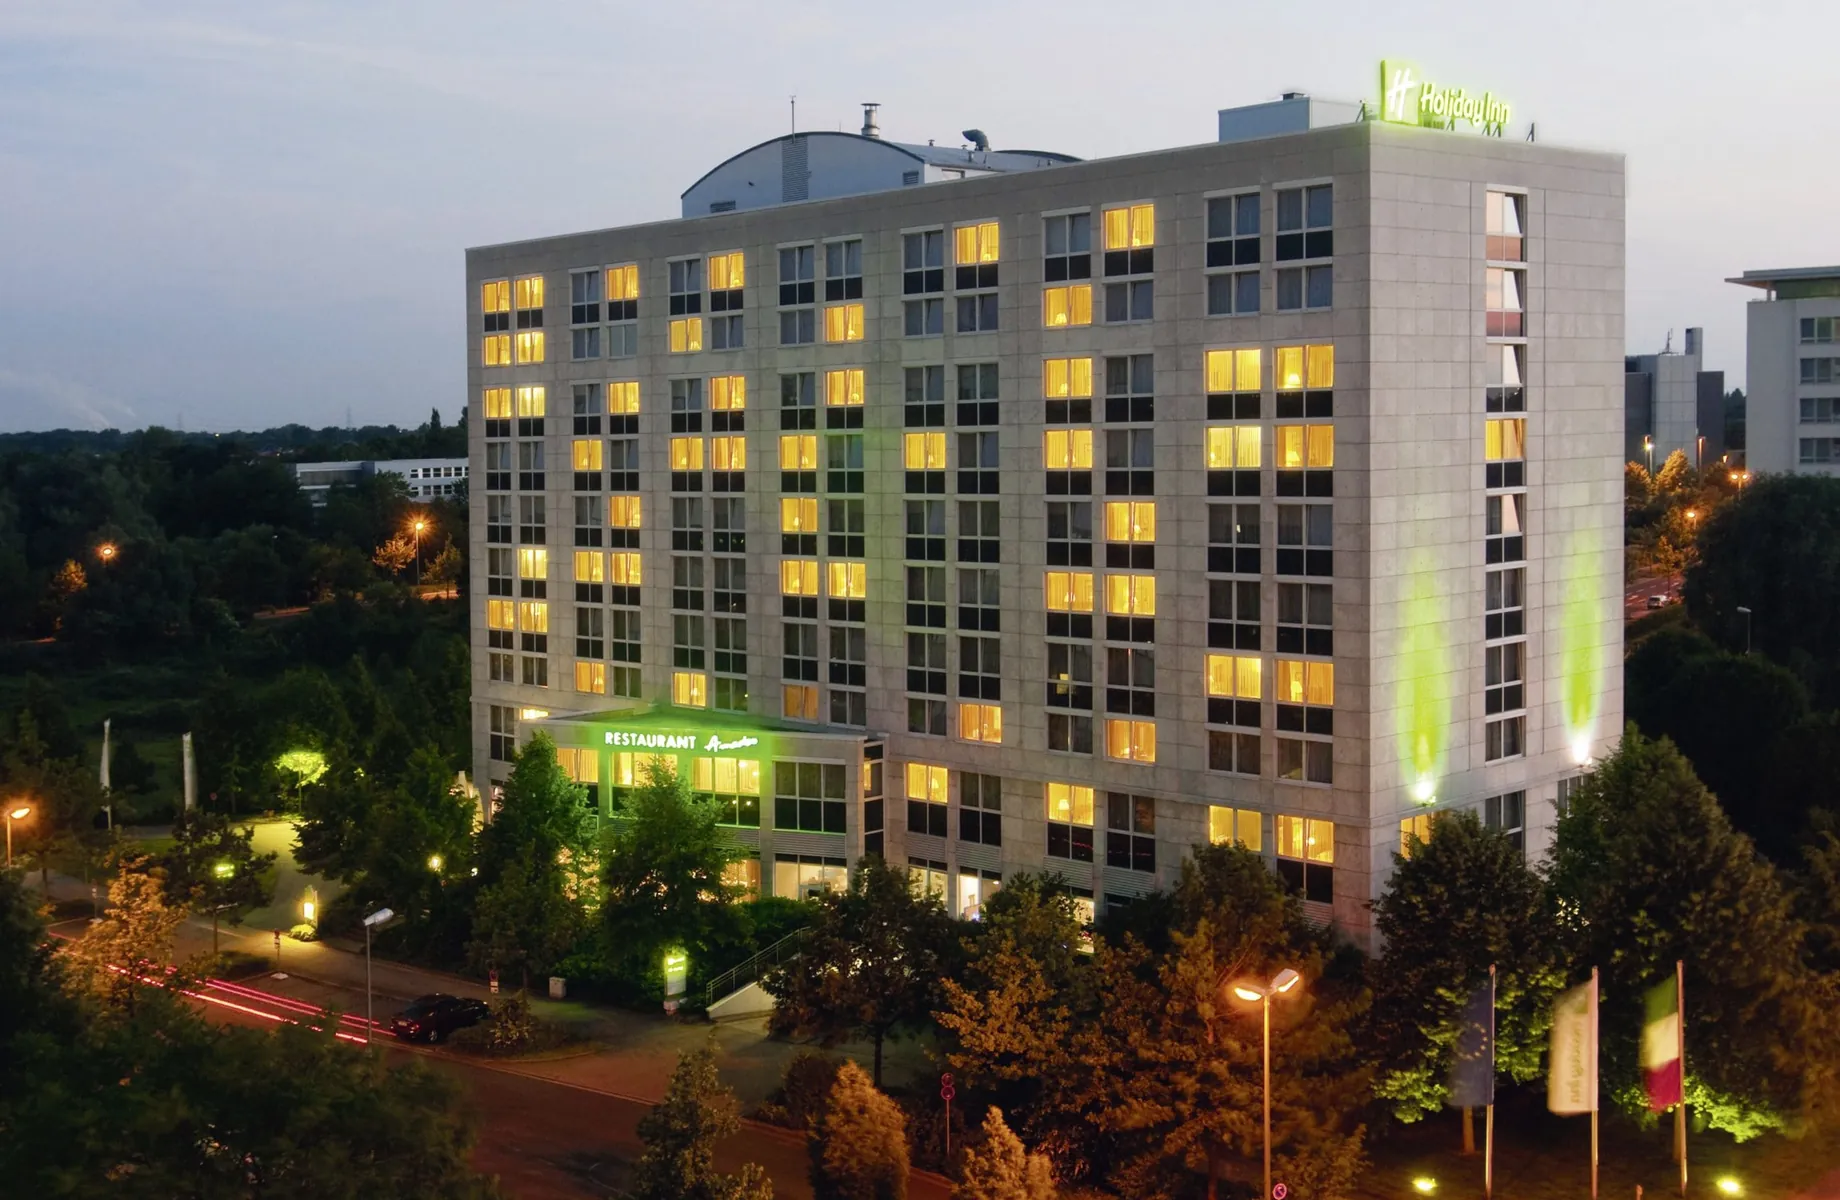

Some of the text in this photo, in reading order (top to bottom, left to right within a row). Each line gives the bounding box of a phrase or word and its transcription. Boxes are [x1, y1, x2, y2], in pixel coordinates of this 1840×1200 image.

[1386, 67, 1416, 121] H
[1420, 81, 1511, 128] Holiday Inn
[604, 731, 697, 750] RESTAURANT
